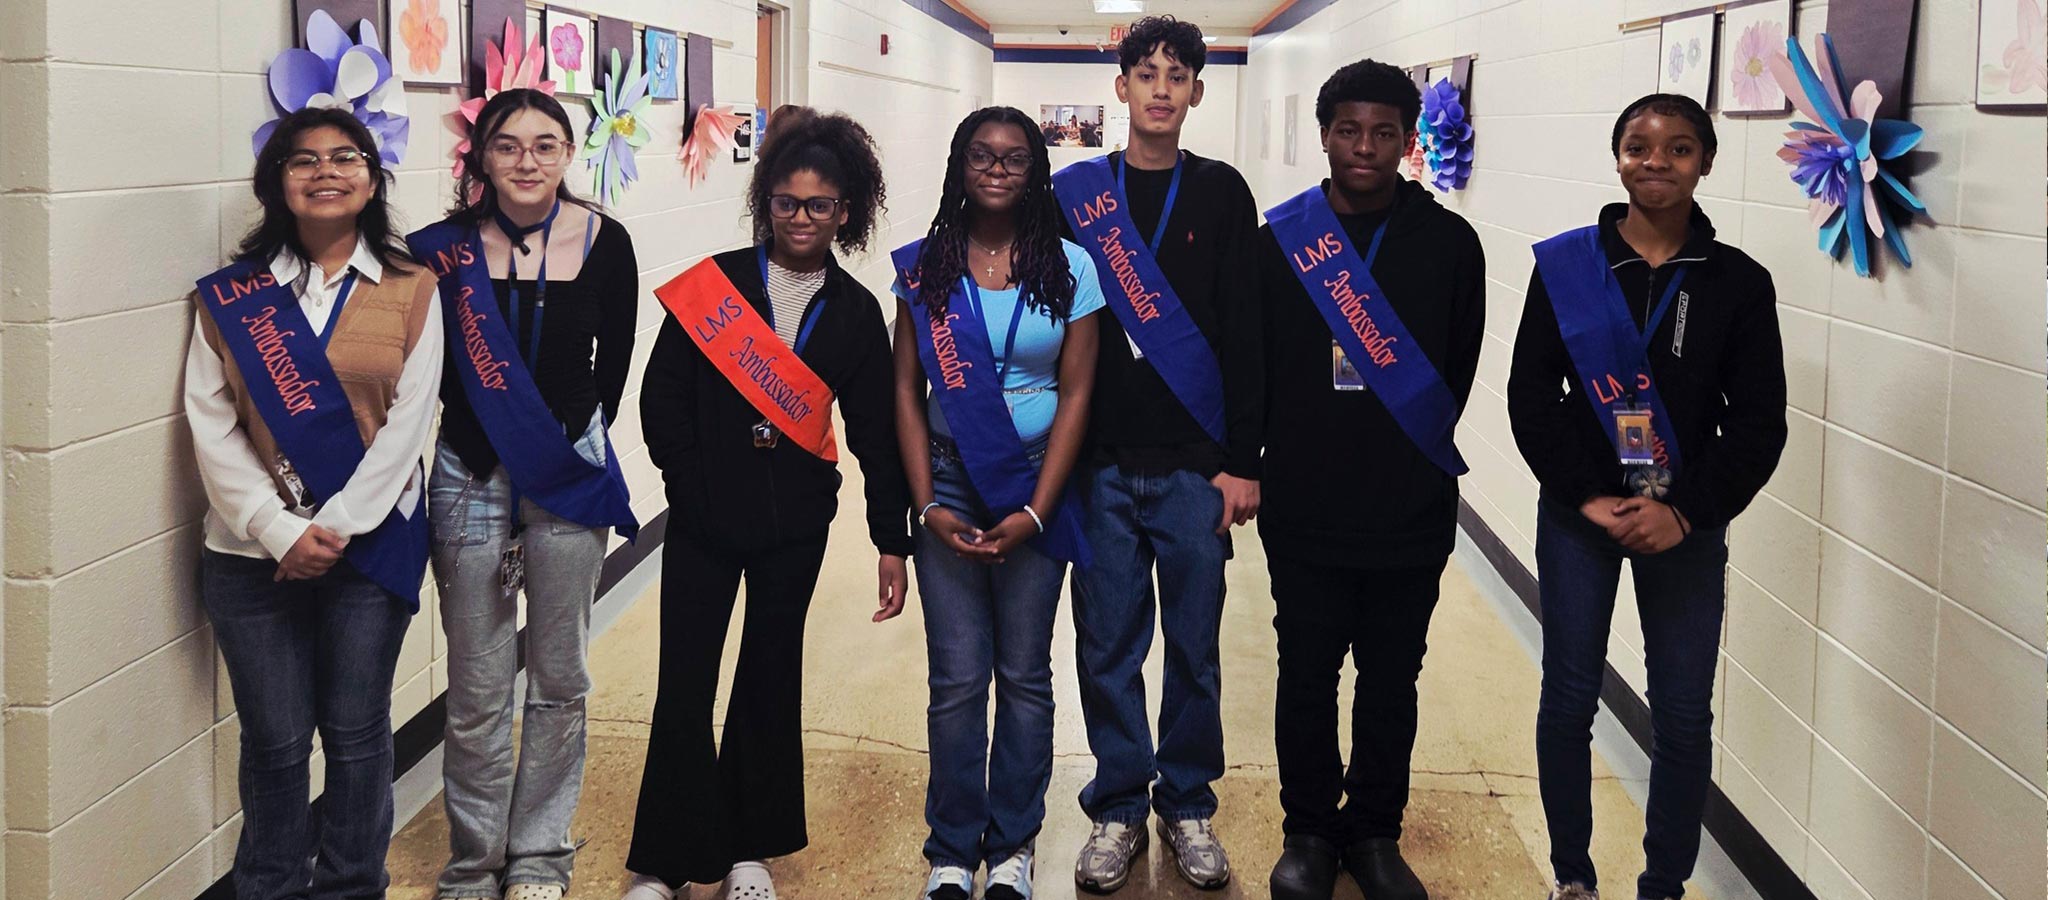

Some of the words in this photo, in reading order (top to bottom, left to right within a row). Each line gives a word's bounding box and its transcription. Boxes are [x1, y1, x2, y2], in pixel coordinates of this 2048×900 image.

[1073, 190, 1118, 228] LMS
[213, 273, 275, 306] LMS
[425, 242, 475, 277] LMS
[1097, 226, 1160, 323] Ambassador
[1294, 232, 1343, 273] LMS
[241, 305, 320, 416] Ambassador
[455, 286, 509, 390] Ambassador
[695, 296, 743, 343] LMS
[929, 306, 973, 390] bassador
[1324, 270, 1397, 368] Ambassador
[729, 335, 812, 423] Ambassador
